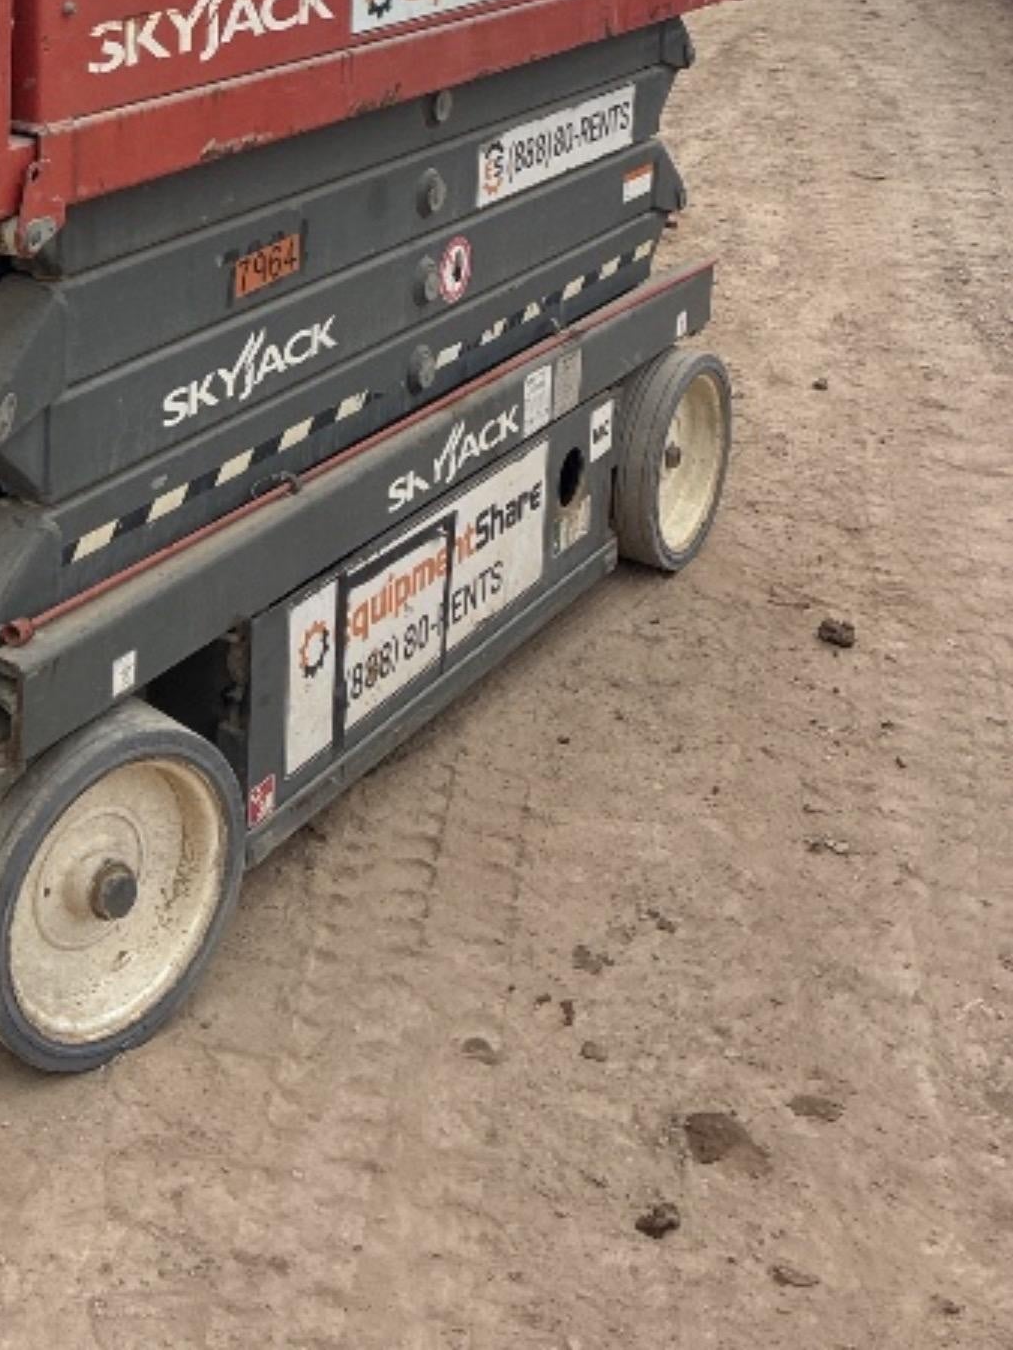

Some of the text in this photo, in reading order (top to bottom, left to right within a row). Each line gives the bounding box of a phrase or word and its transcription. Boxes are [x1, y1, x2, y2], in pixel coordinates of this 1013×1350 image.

[236, 236, 297, 293] 7964
[162, 314, 339, 428] SKYJACK
[388, 404, 520, 514] SKYJACK
[349, 481, 543, 645] quipmentShare
